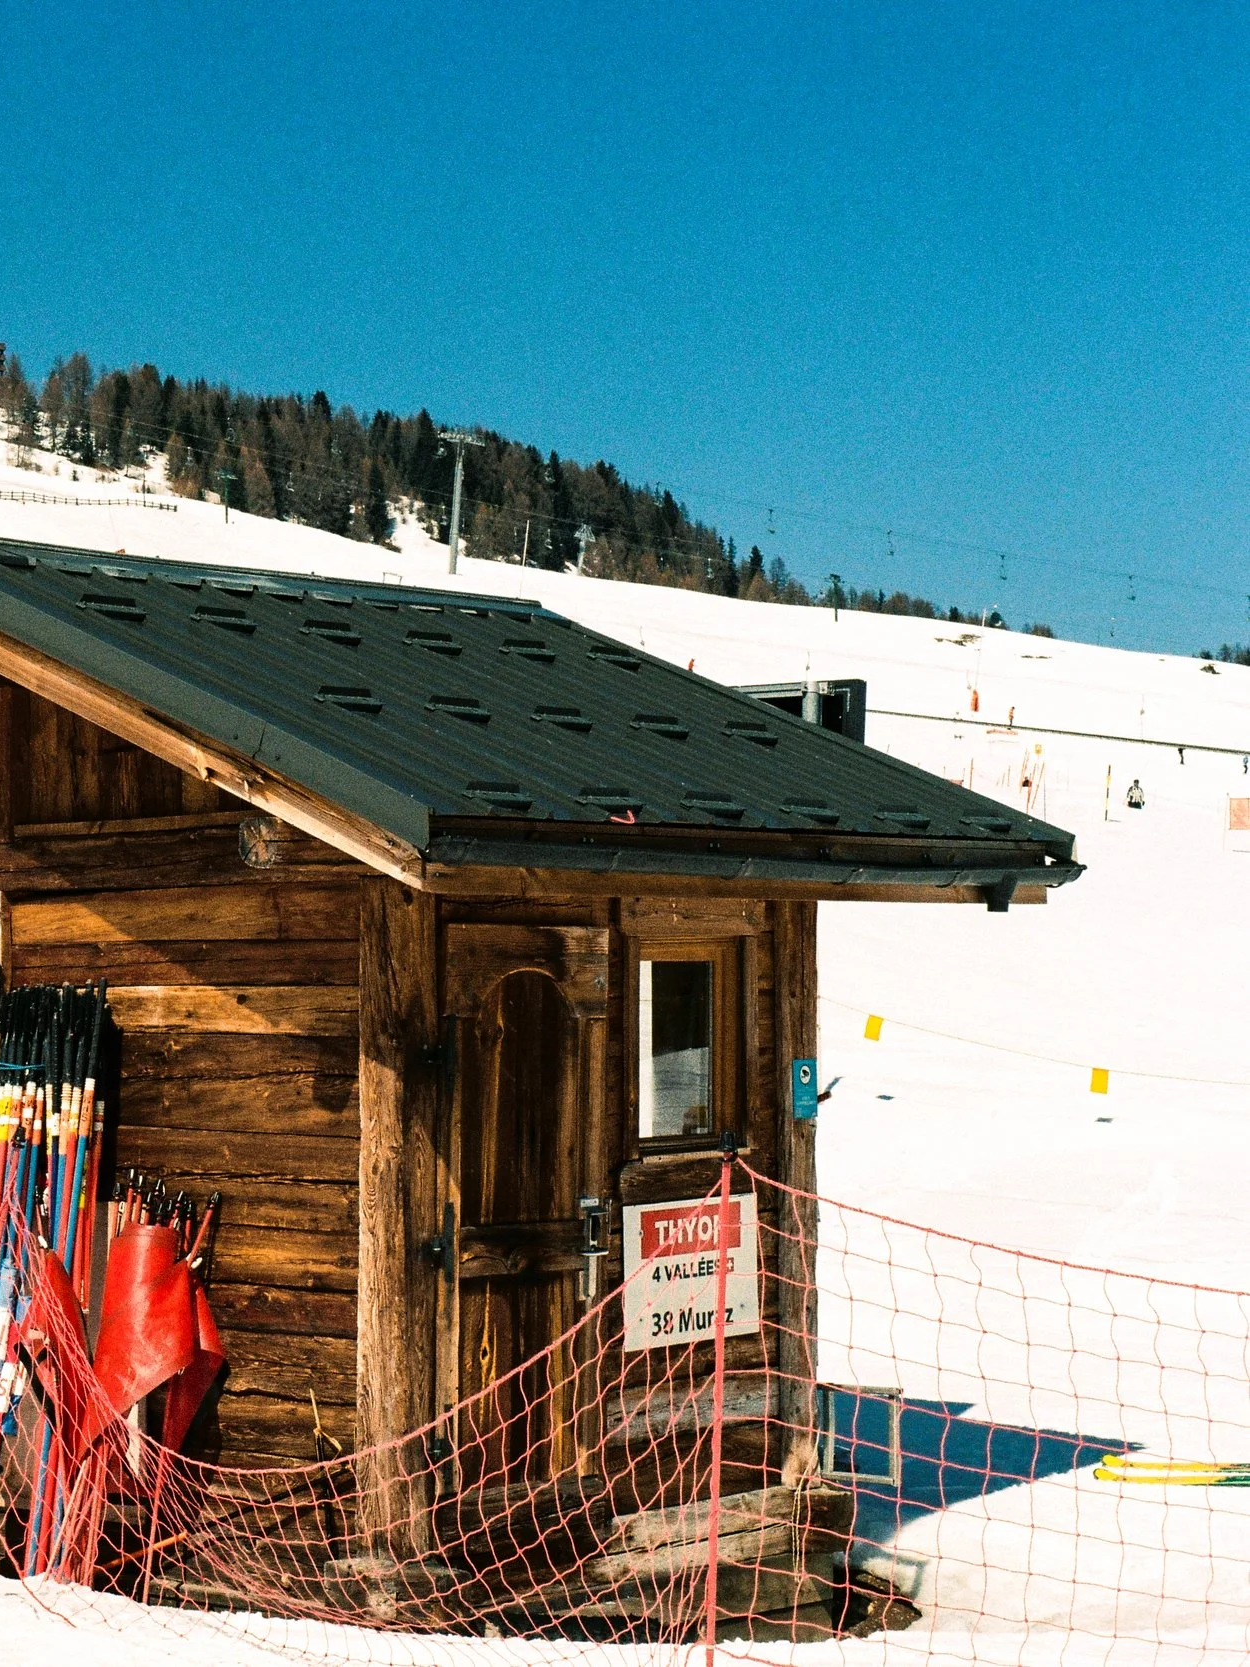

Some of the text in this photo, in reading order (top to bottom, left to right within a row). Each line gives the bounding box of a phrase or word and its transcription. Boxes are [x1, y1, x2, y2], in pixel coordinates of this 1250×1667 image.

[652, 1266, 661, 1282] 4
[652, 1307, 734, 1337] 38 Murz
